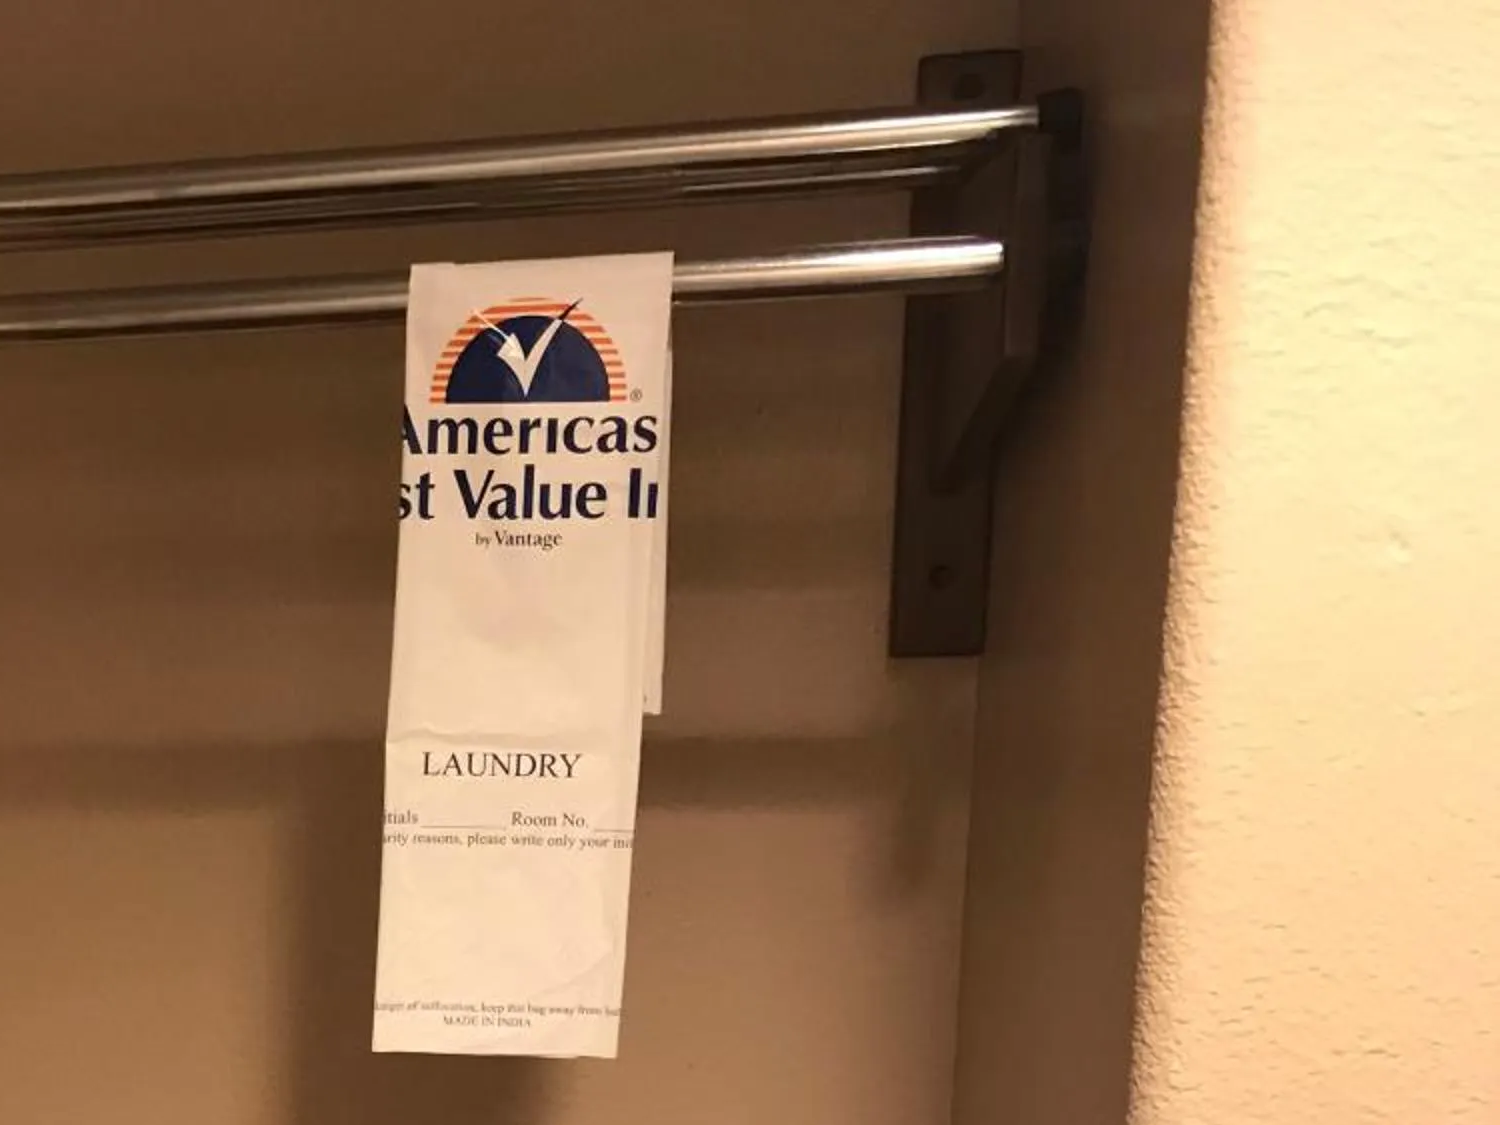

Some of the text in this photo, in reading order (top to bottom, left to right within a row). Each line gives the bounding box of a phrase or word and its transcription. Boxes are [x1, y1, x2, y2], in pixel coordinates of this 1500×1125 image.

[454, 463, 607, 520] Value
[475, 529, 563, 550] by Vantage
[422, 751, 584, 779] LAUNDRY
[511, 811, 557, 827] Room
[562, 812, 590, 829] No.
[413, 833, 464, 846] reasons,
[467, 832, 507, 848] please
[511, 834, 544, 847] write
[547, 834, 575, 851] only
[578, 838, 610, 851] your
[481, 1001, 505, 1015] keep
[527, 1002, 546, 1017] bag
[443, 1015, 532, 1029] MADE IN INDIA
